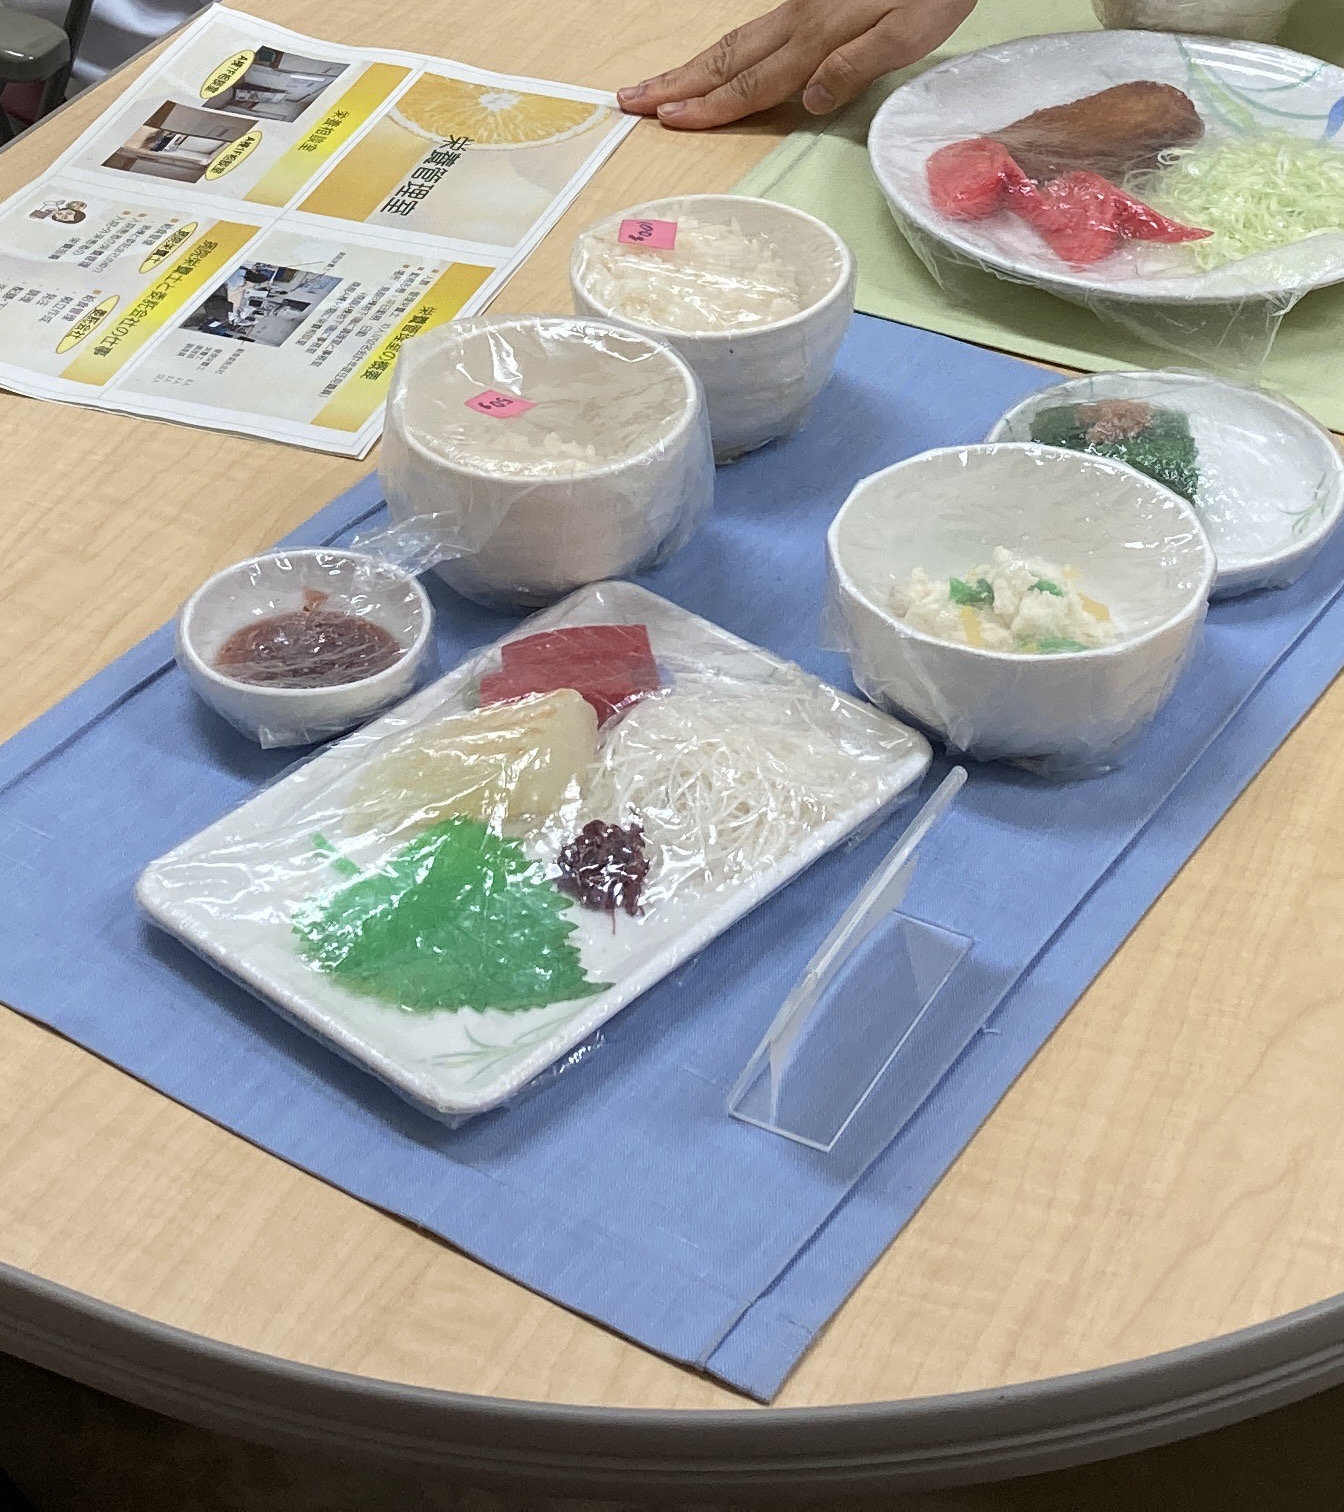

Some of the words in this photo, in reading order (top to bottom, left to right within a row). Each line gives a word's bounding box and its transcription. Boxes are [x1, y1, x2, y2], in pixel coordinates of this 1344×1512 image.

[296, 108, 351, 154] 栄養相談室
[377, 132, 476, 218] 栄養管理室
[65, 307, 108, 340] 委託会社
[87, 239, 220, 357] 病院栄養士と委託会社の仕事
[358, 304, 437, 382] 栄養管理室の概要
